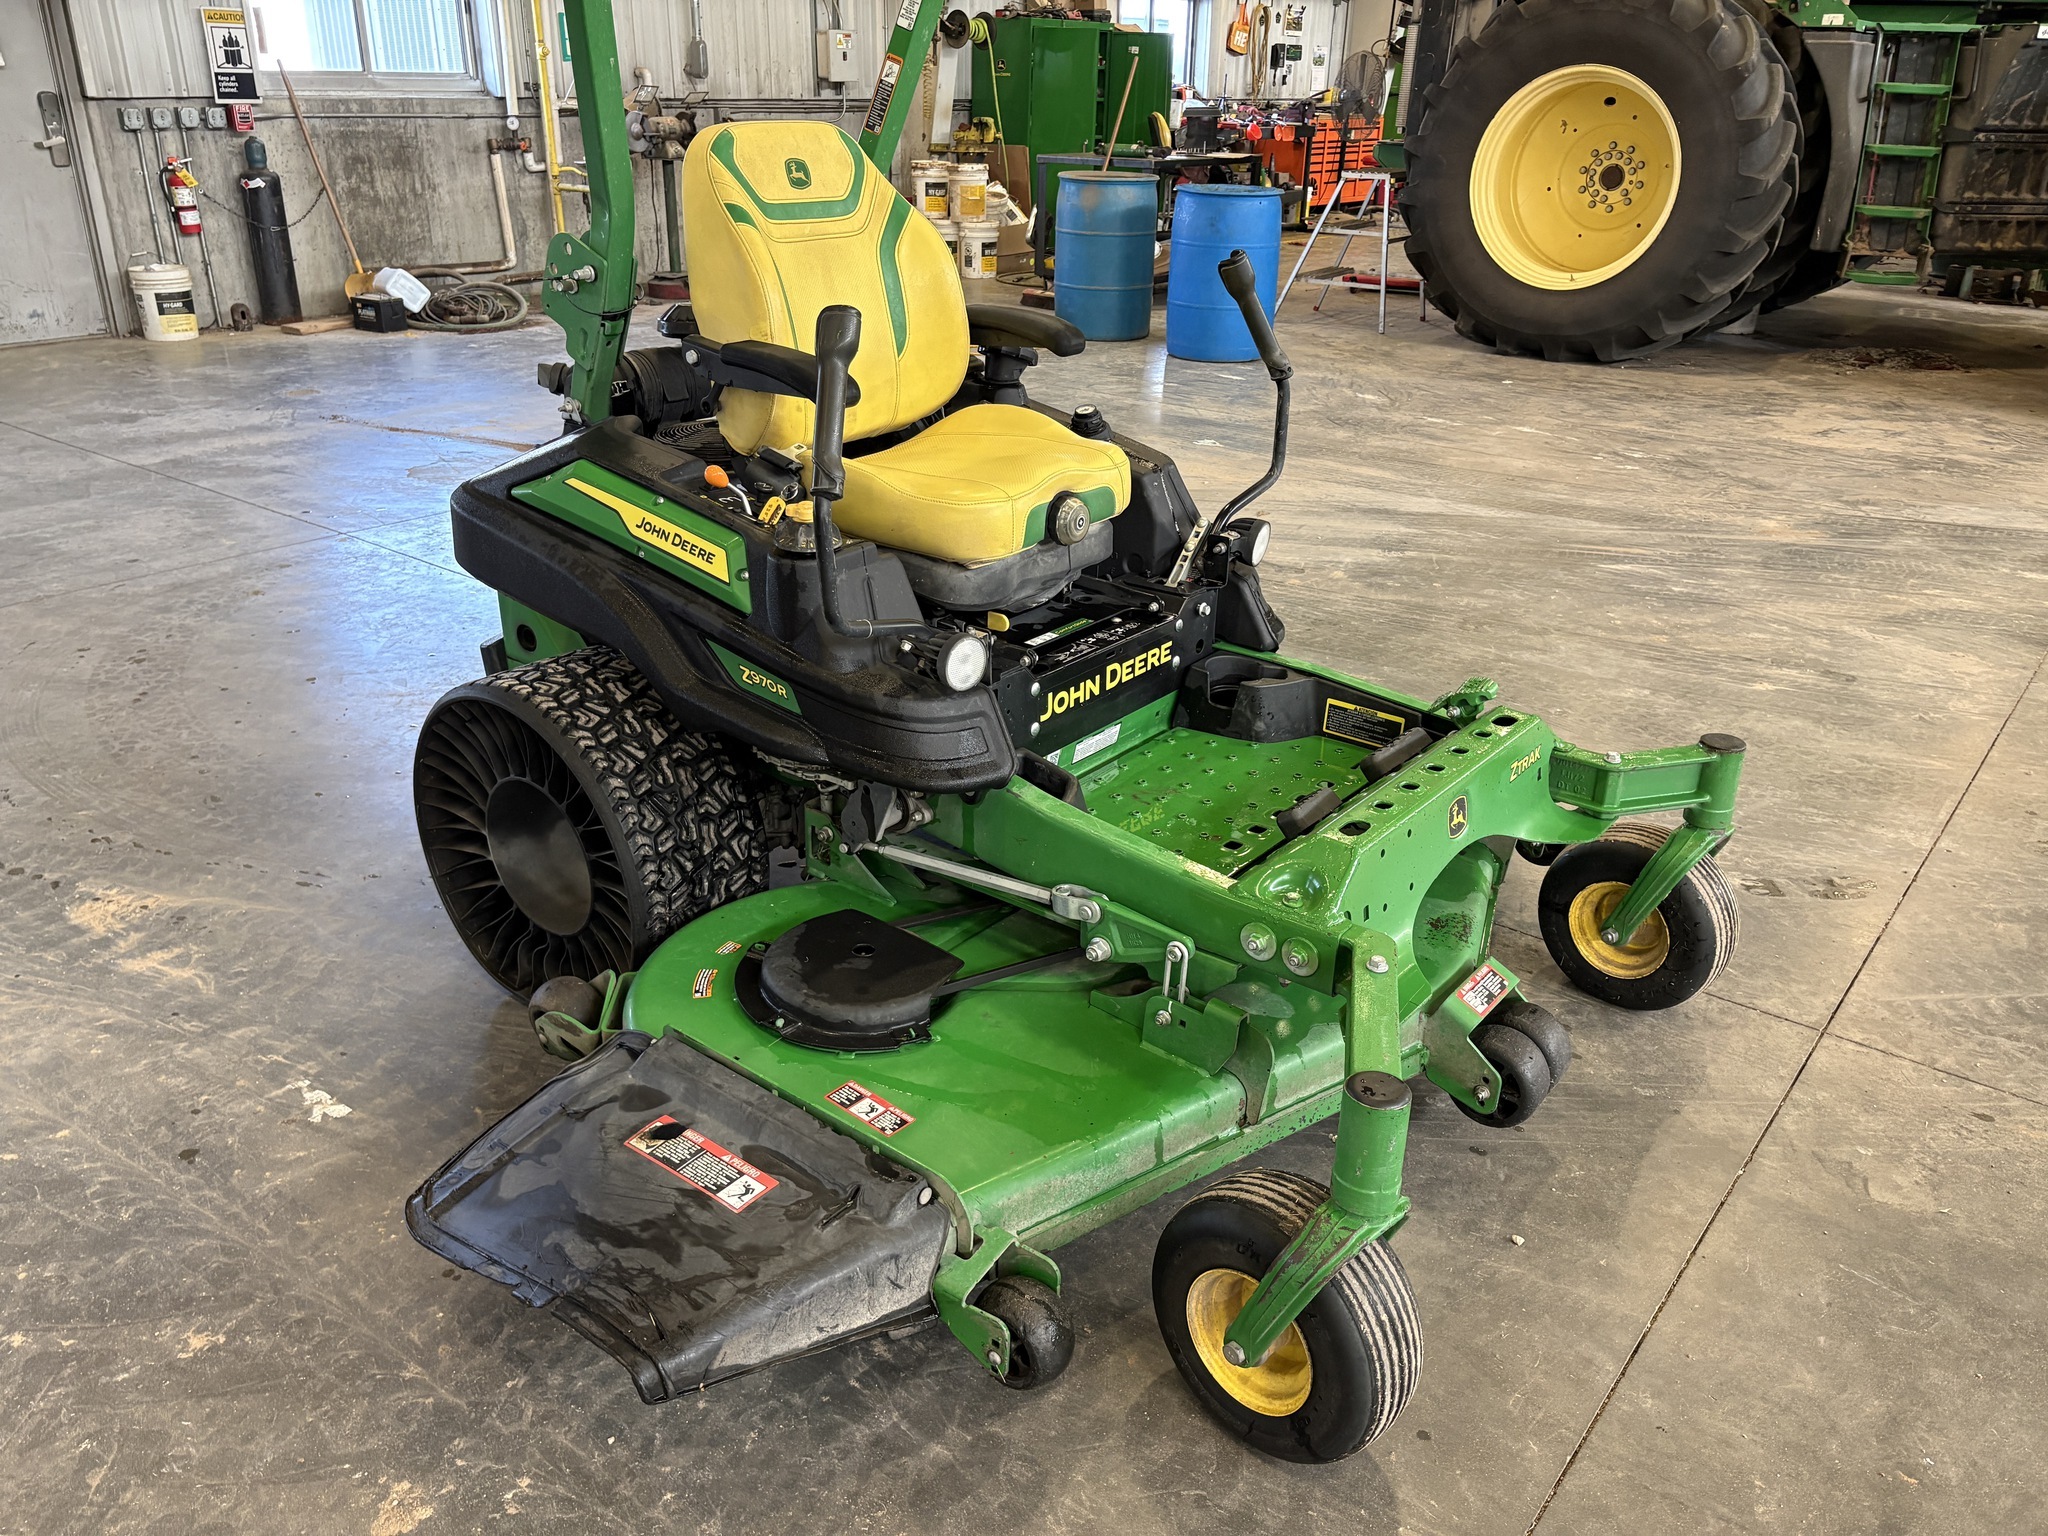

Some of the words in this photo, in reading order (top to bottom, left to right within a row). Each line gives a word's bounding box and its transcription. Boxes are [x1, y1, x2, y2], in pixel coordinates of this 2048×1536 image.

[1233, 30, 1248, 48] HE
[635, 517, 671, 542] JOHN
[671, 532, 716, 565] DEERE
[739, 664, 788, 699] Z970R
[1040, 674, 1100, 722] JOHN
[1106, 640, 1173, 691] DEERE
[1509, 743, 1542, 783] ZTRAK
[681, 1129, 705, 1144] NGER
[731, 1157, 761, 1178] PELIGRO
